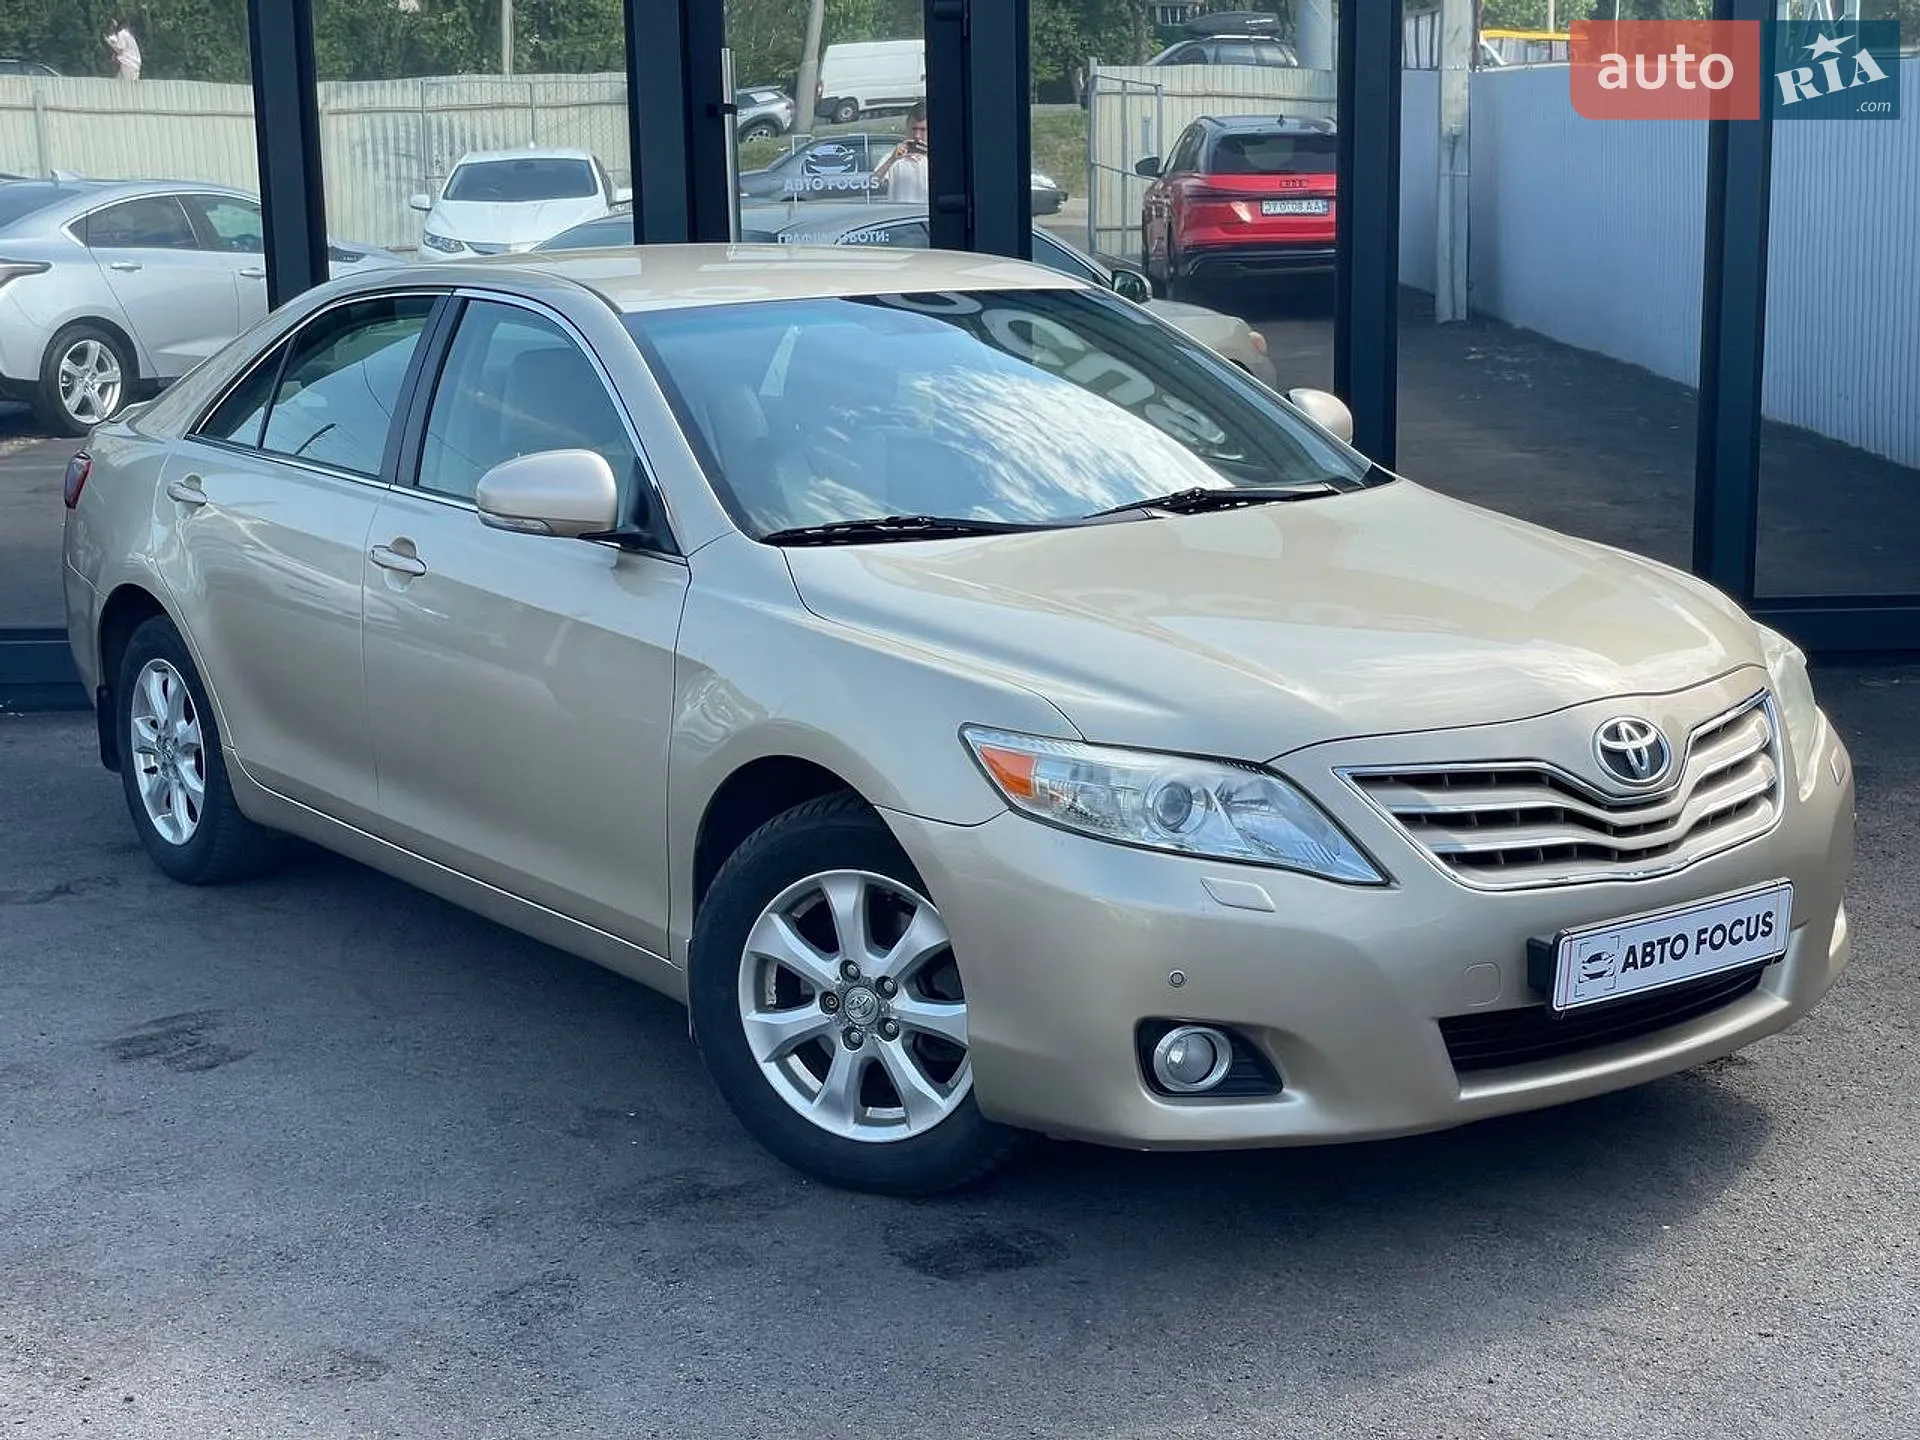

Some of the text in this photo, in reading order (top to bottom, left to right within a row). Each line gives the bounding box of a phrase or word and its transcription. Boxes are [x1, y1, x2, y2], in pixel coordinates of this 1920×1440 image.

[784, 175, 880, 192] АВТО FOCUS
[1620, 910, 1776, 974] АВТО FOCUS
